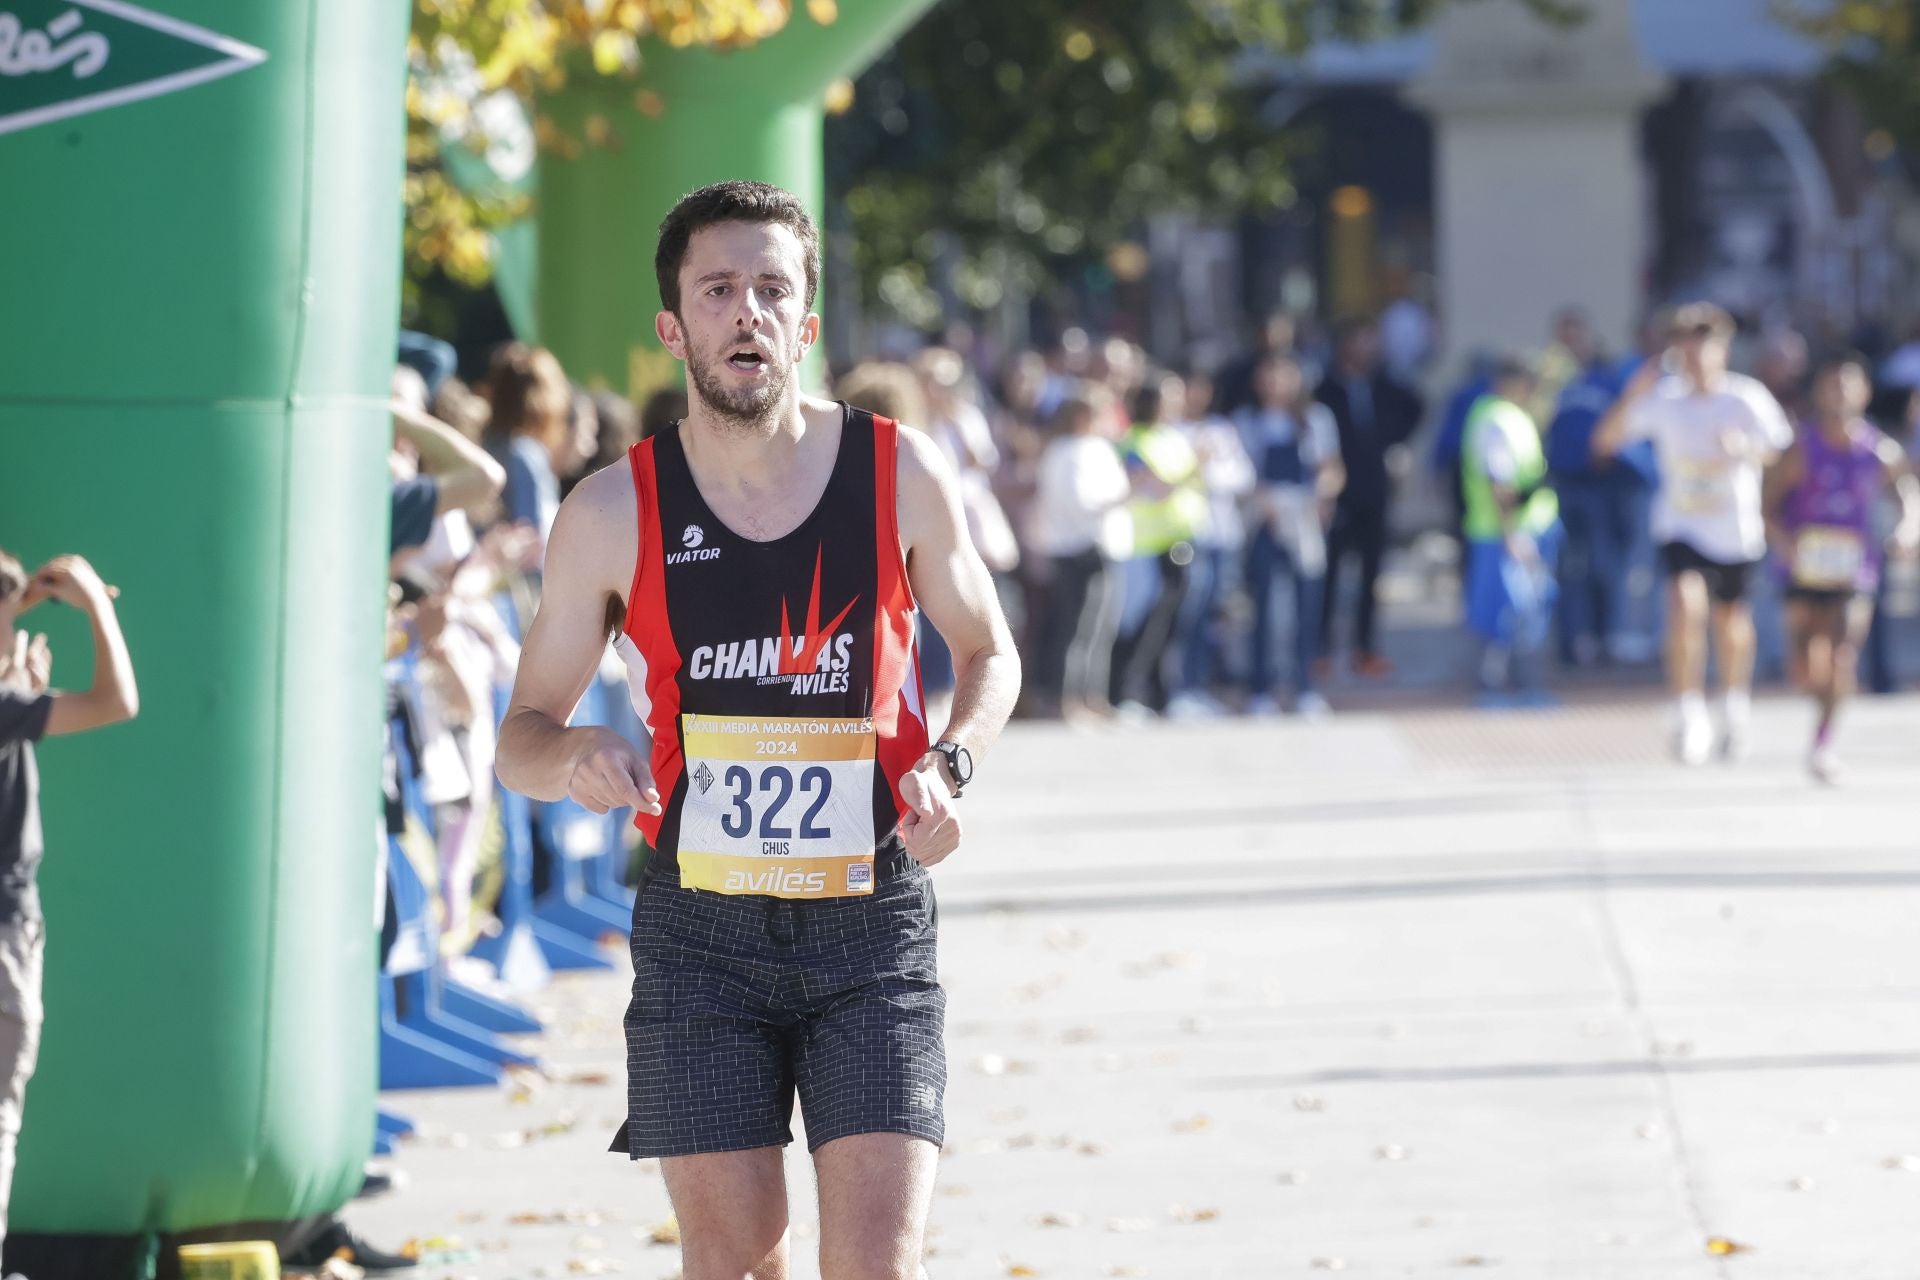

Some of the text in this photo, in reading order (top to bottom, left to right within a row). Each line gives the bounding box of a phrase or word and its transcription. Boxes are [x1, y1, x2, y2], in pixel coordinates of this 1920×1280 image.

[667, 547, 720, 565] VIATOR
[757, 672, 850, 695] CORRIENDO AVILES
[720, 722, 760, 734] MEDIA
[763, 720, 828, 734] MARATÓN
[831, 718, 873, 734] AVILÉS
[755, 741, 797, 755] 2024
[721, 765, 832, 838] 322
[762, 842, 790, 856] CHUS
[725, 866, 826, 892] avilés
